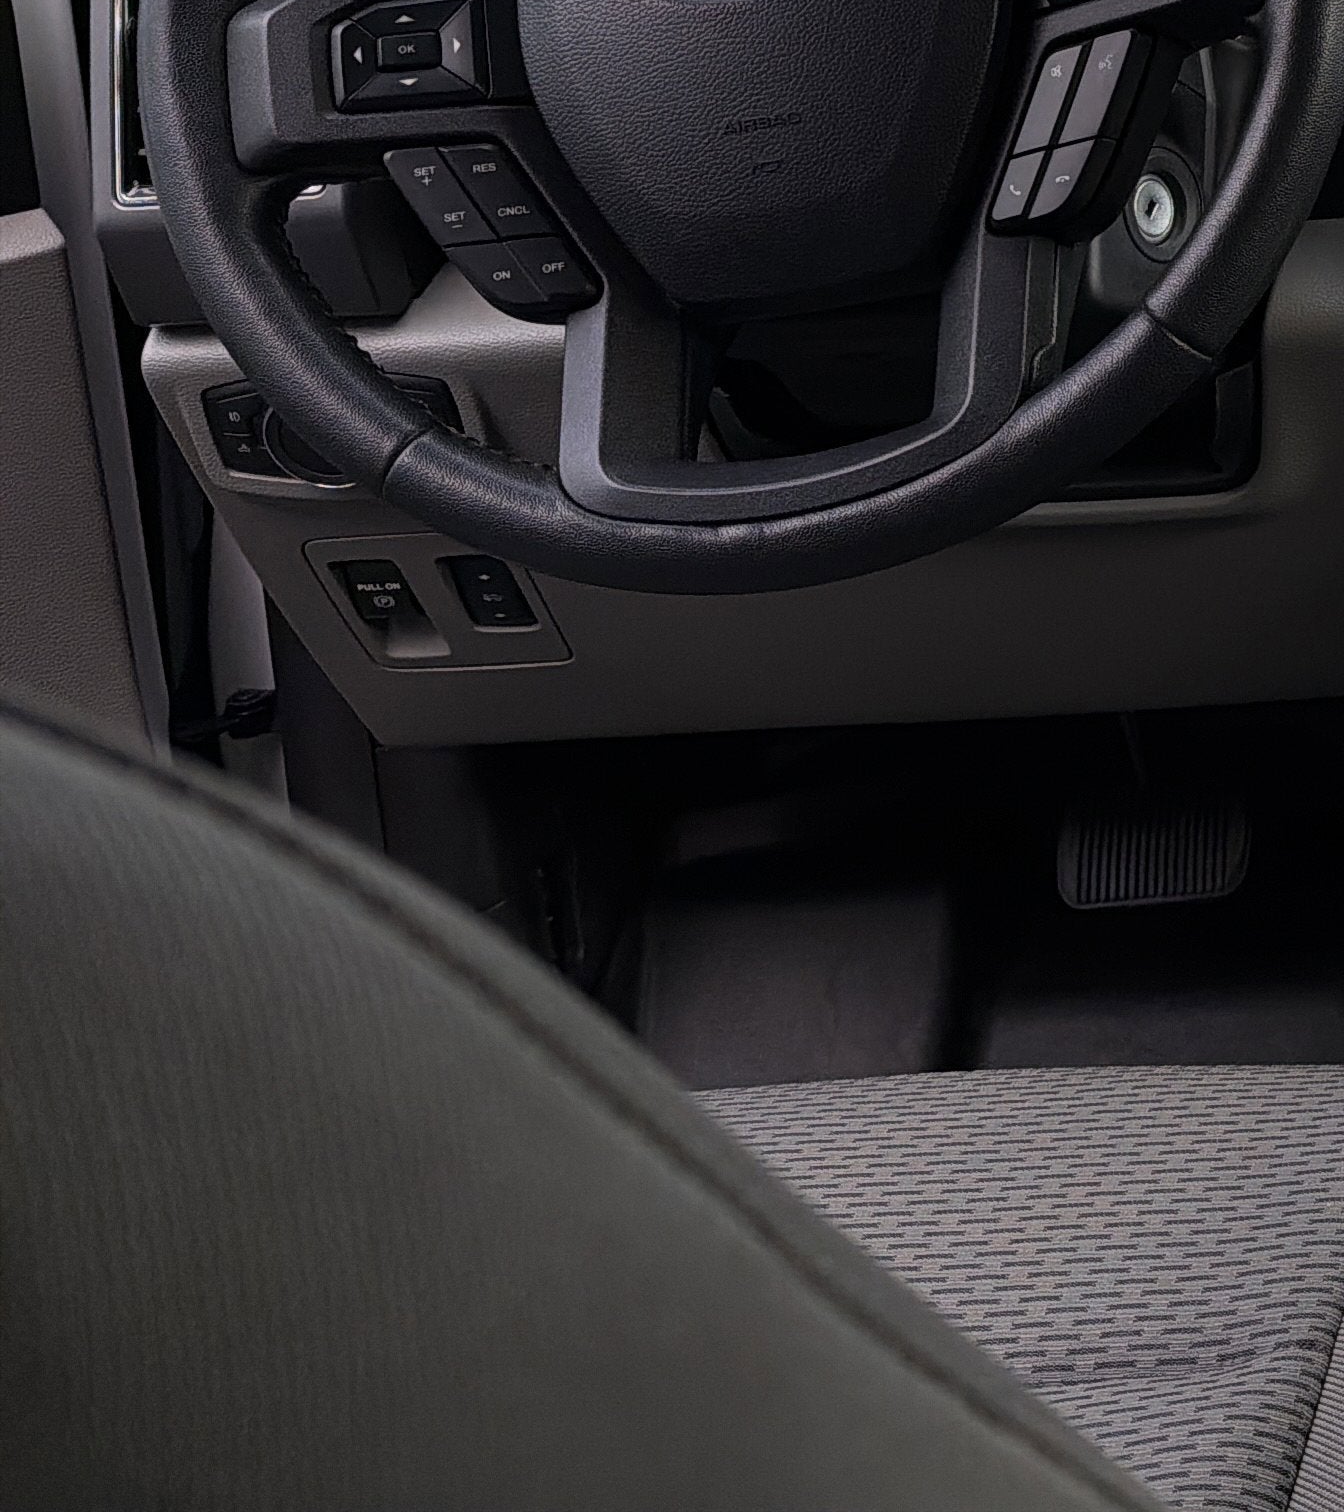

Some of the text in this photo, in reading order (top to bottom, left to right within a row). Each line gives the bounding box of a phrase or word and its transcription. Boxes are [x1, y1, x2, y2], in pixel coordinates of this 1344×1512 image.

[398, 44, 416, 55] OK
[413, 165, 436, 177] SET
[472, 163, 497, 174] RES
[497, 205, 530, 217] CNCL
[443, 211, 466, 223] SET
[542, 261, 566, 273] OFF
[492, 270, 511, 281] ON
[357, 583, 384, 591] PULL
